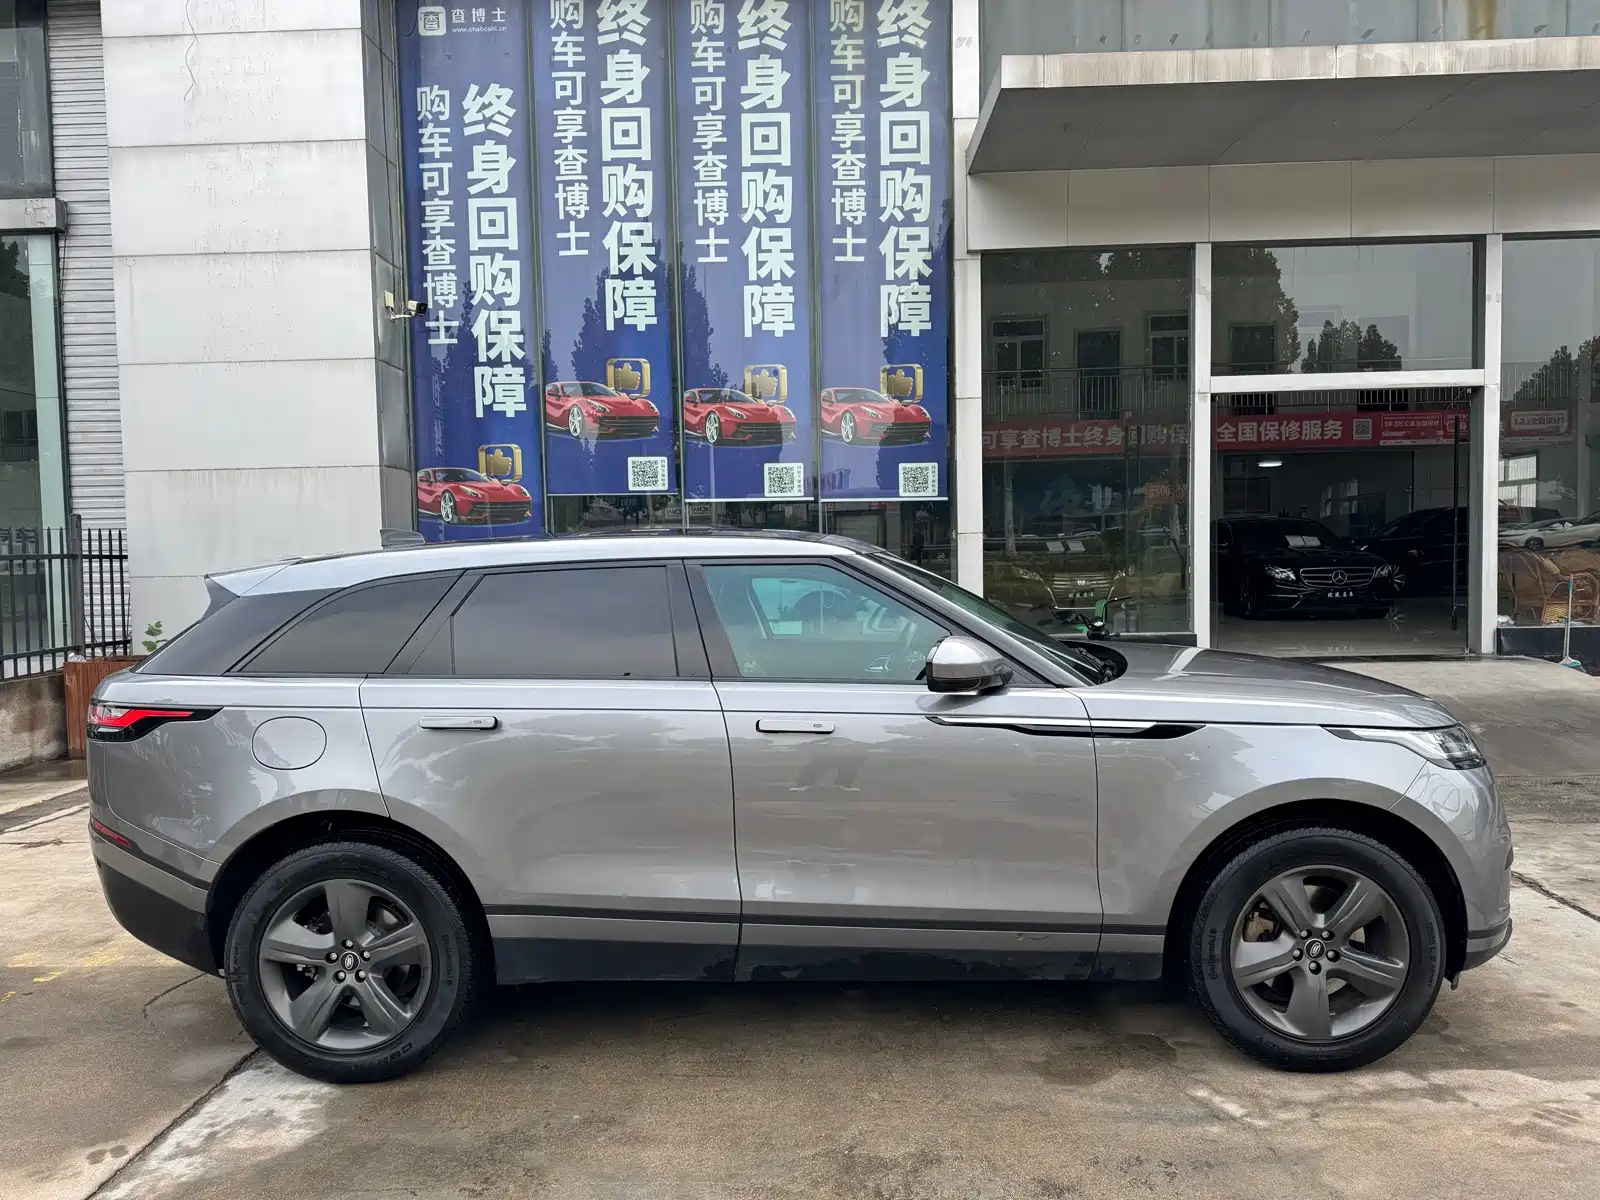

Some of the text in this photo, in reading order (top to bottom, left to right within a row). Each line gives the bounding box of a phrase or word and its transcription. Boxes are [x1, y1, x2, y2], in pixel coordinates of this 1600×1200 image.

[451, 8, 506, 23] 查博士
[550, 0, 590, 256] 购车可享查博士
[690, 0, 729, 262] 购车可享查博士
[830, 0, 867, 262] 购车可享查博士
[416, 85, 459, 344] 购车可享查博士
[462, 83, 527, 418] 终身回购保障
[596, 0, 657, 331] 终身回购保障
[737, 0, 795, 337] 终身回购保障
[877, 0, 933, 337] 终身回购保障
[1217, 420, 1344, 442] 全国保修服务
